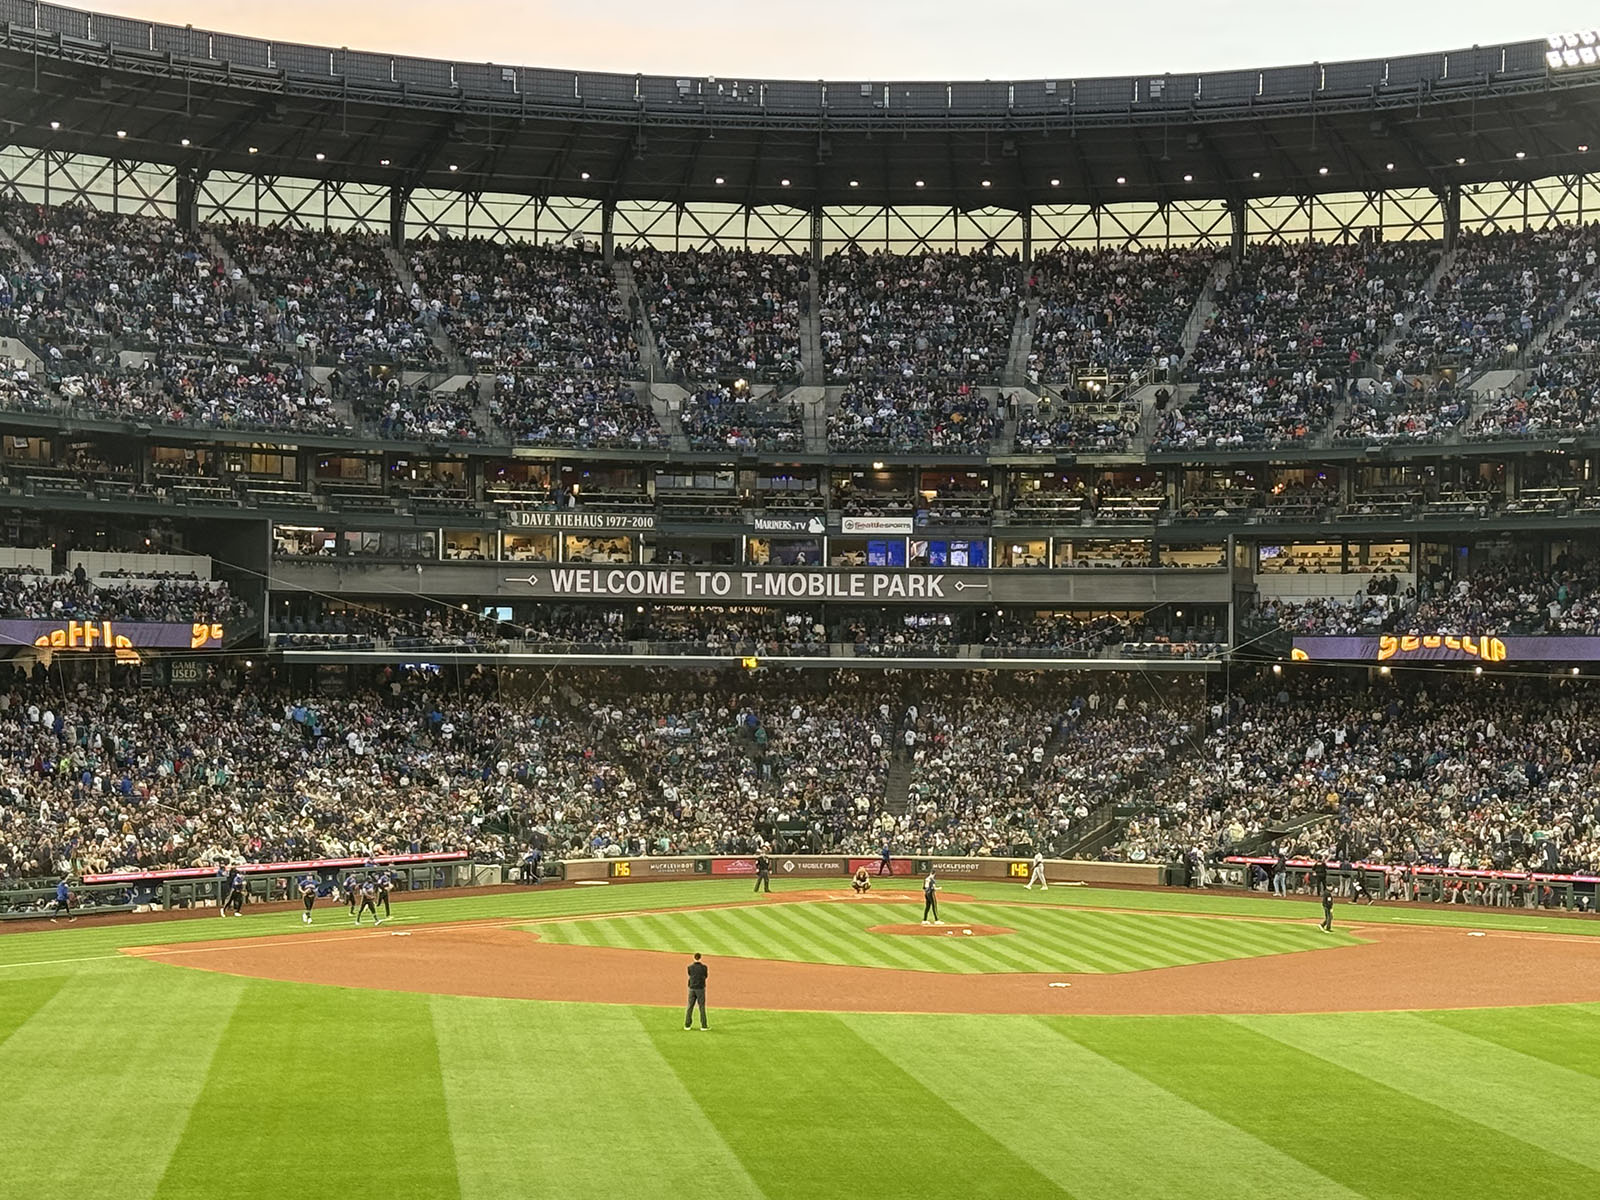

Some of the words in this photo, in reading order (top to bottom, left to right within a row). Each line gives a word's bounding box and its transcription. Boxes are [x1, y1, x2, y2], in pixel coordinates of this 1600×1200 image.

[522, 513, 551, 526] DAVE
[554, 514, 604, 527] NIEHAUS
[606, 516, 654, 528] 1977-2010
[551, 570, 686, 596] WELCOME
[696, 572, 731, 597] TO
[742, 573, 865, 598] T-MOBILE
[873, 574, 945, 598] PARK
[171, 661, 197, 670] GAME
[171, 669, 197, 679] USED
